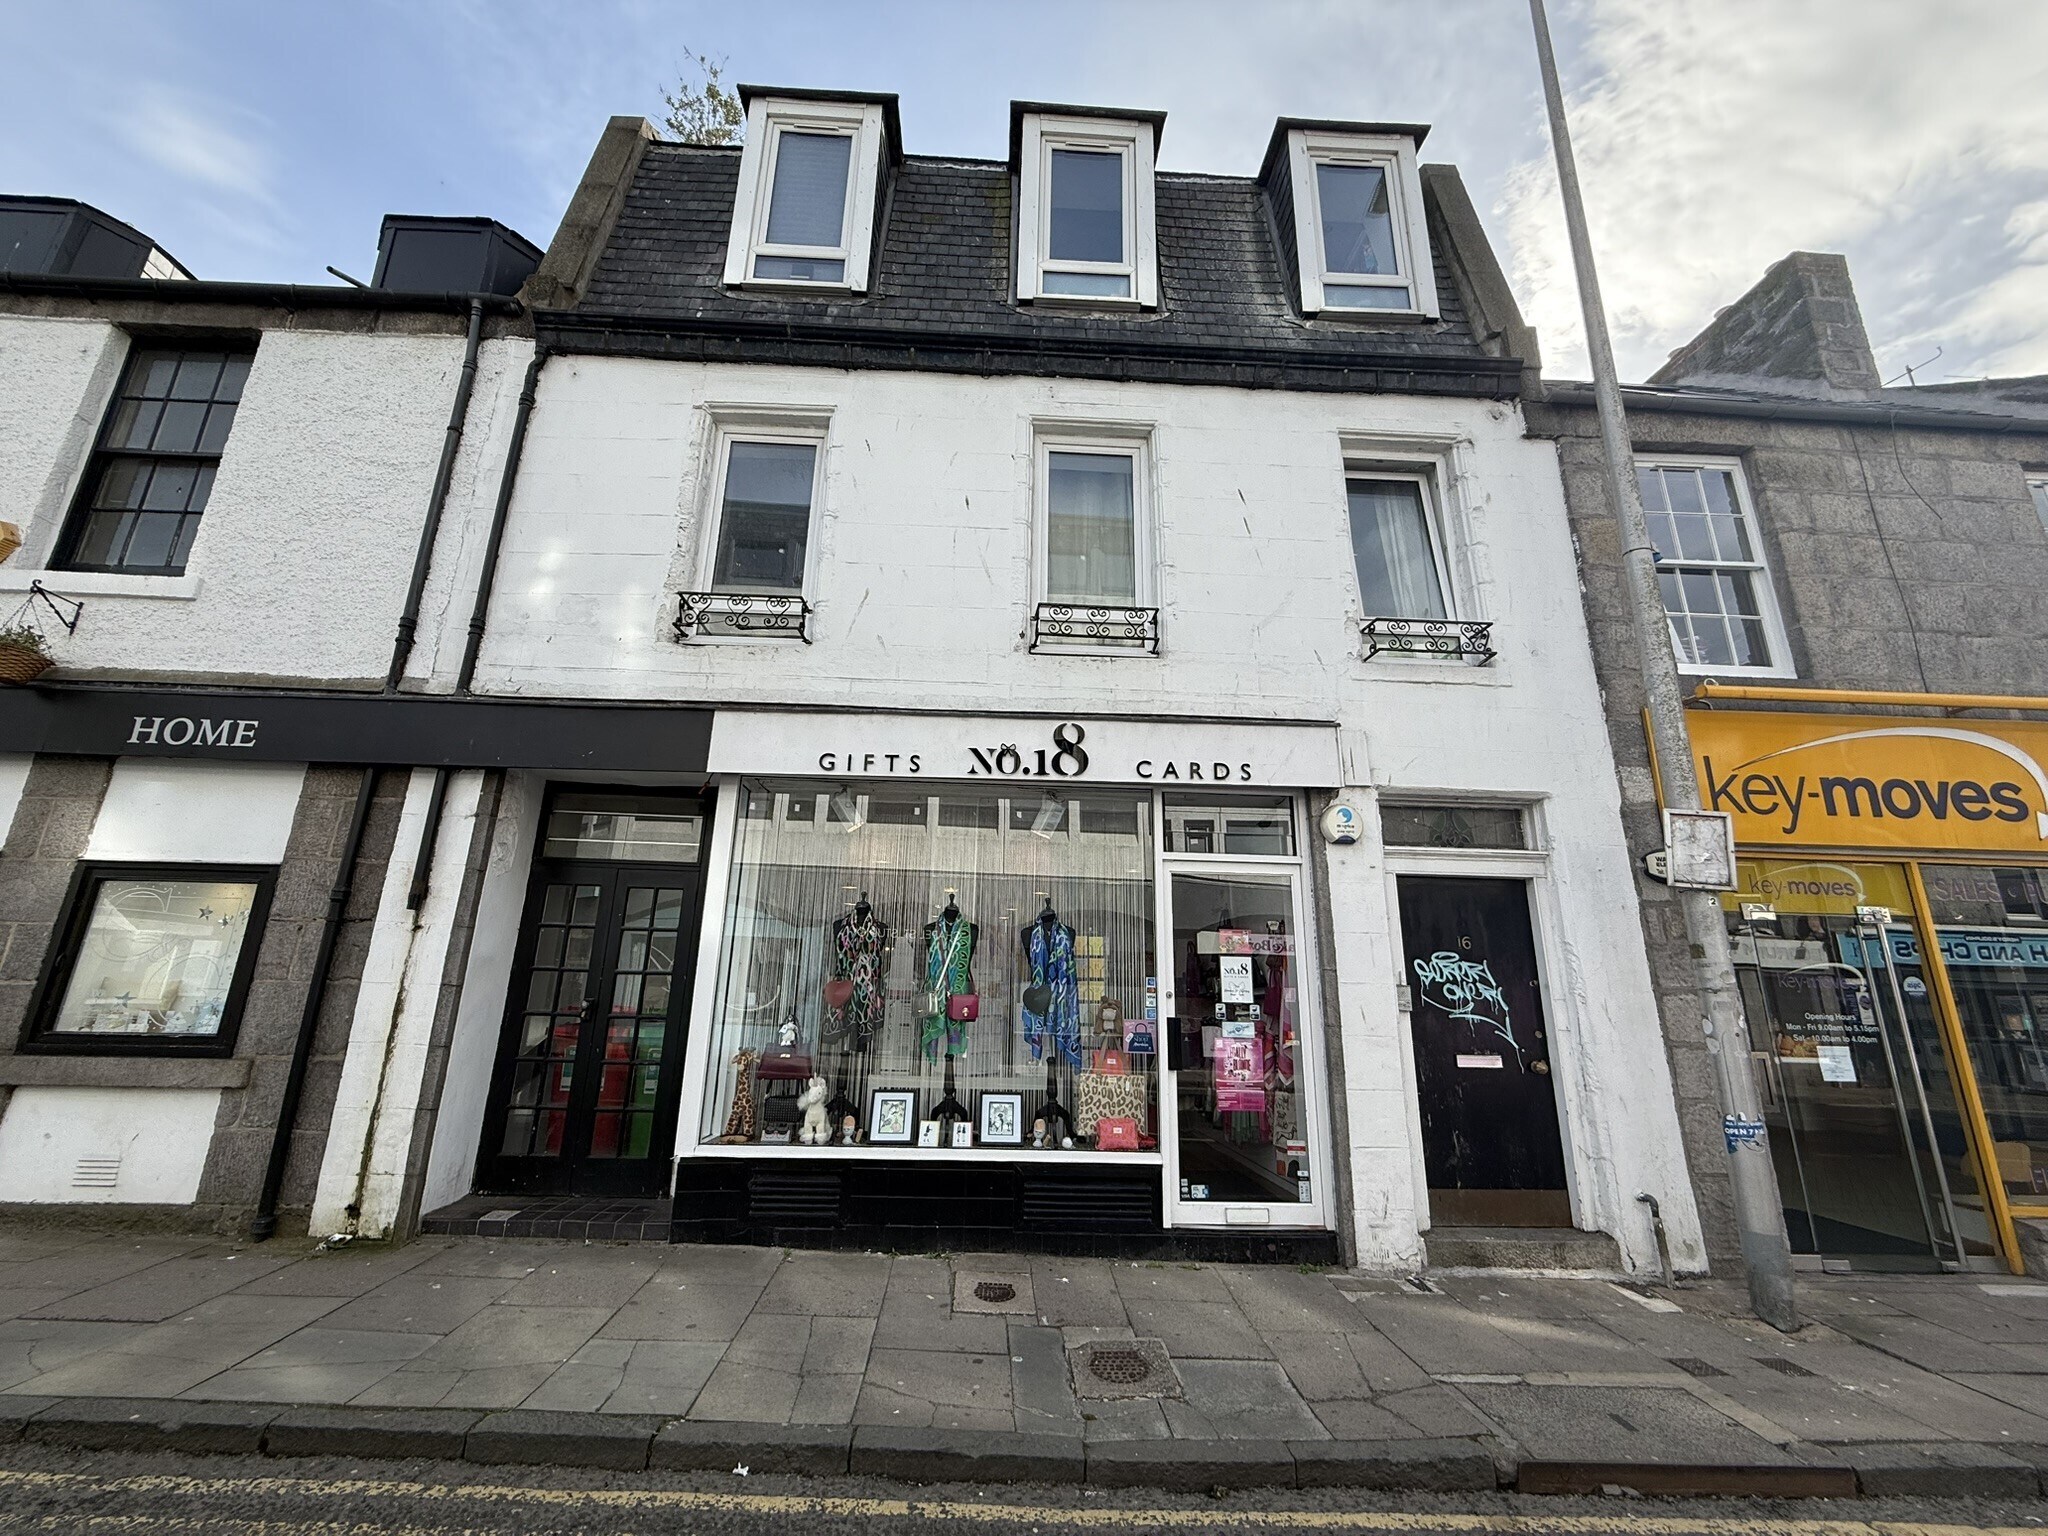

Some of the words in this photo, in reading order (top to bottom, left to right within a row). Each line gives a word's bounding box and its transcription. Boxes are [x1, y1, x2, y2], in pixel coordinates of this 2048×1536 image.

[127, 716, 259, 749] HOME
[818, 752, 923, 773] GIFTS
[1136, 760, 1254, 782] CARDS
[1703, 755, 2030, 834] key-moves
[1747, 873, 1858, 900] key-moves
[1933, 877, 2003, 903] SALES
[1710, 897, 1717, 906] 2
[1456, 935, 1472, 950] 16
[1786, 1022, 1802, 1031] Mon
[1807, 1023, 1816, 1031] Fri
[1845, 1024, 1853, 1032] to
[1804, 1012, 1834, 1021] Opening
[1836, 1012, 1857, 1020] Hours
[1793, 1033, 1805, 1042] Sat
[1842, 1035, 1850, 1043] to
